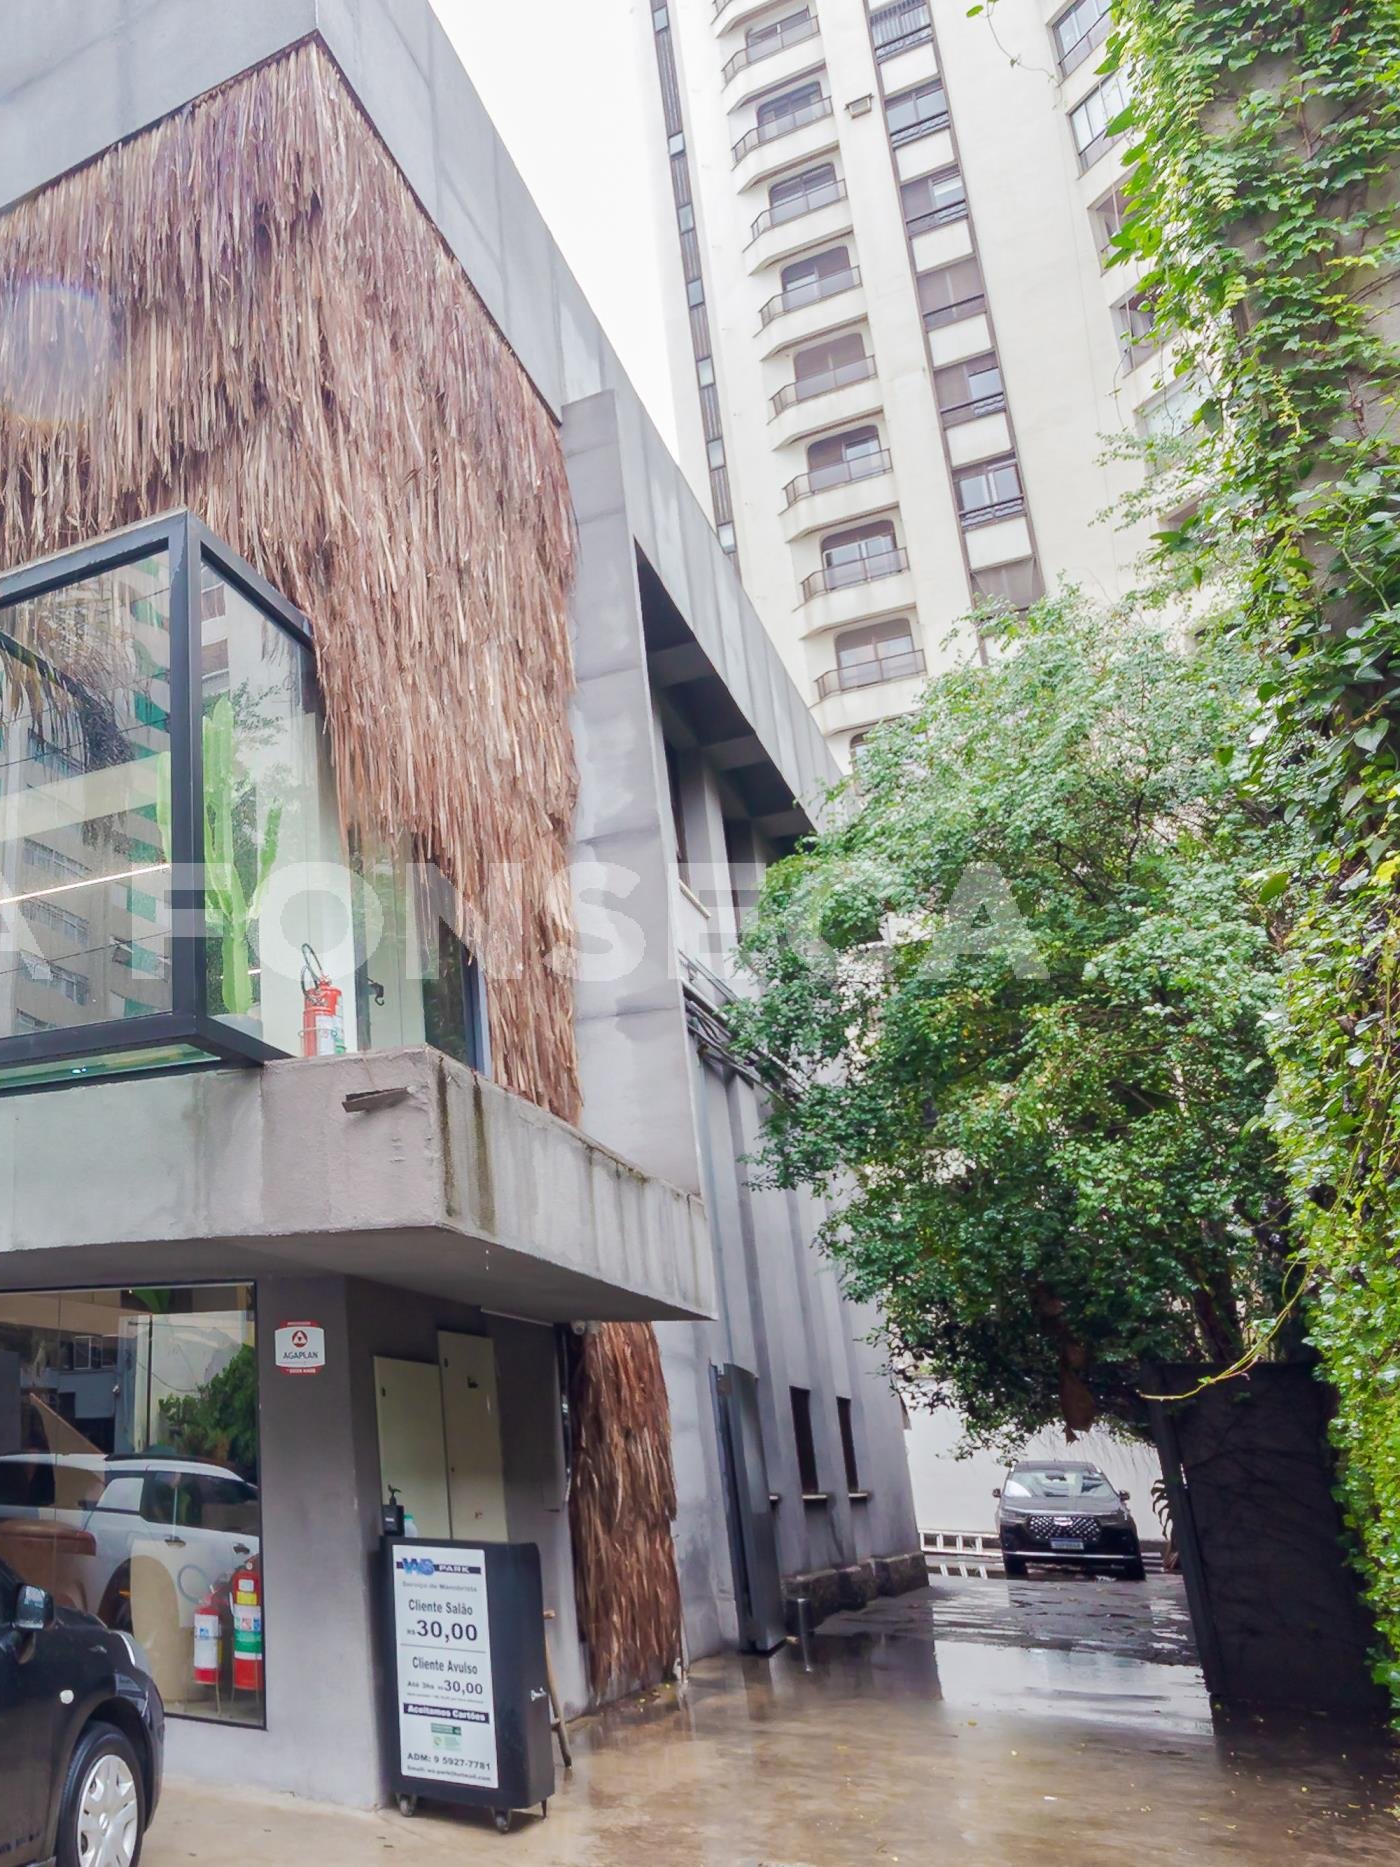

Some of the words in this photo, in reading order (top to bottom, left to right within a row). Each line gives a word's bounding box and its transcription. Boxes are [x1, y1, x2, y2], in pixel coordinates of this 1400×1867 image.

[282, 1351, 319, 1360] AGAPLAN
[439, 1564, 470, 1574] PARK
[408, 1598, 443, 1614] Cliente
[445, 1602, 473, 1616] Salão
[416, 1619, 478, 1643] 30,00
[412, 1656, 444, 1672] Cliente
[447, 1660, 478, 1675] Avulso
[444, 1680, 483, 1696] 30,00
[407, 1705, 451, 1717] Aceitamos
[407, 1752, 431, 1762] ADM:
[433, 1755, 440, 1763] 9
